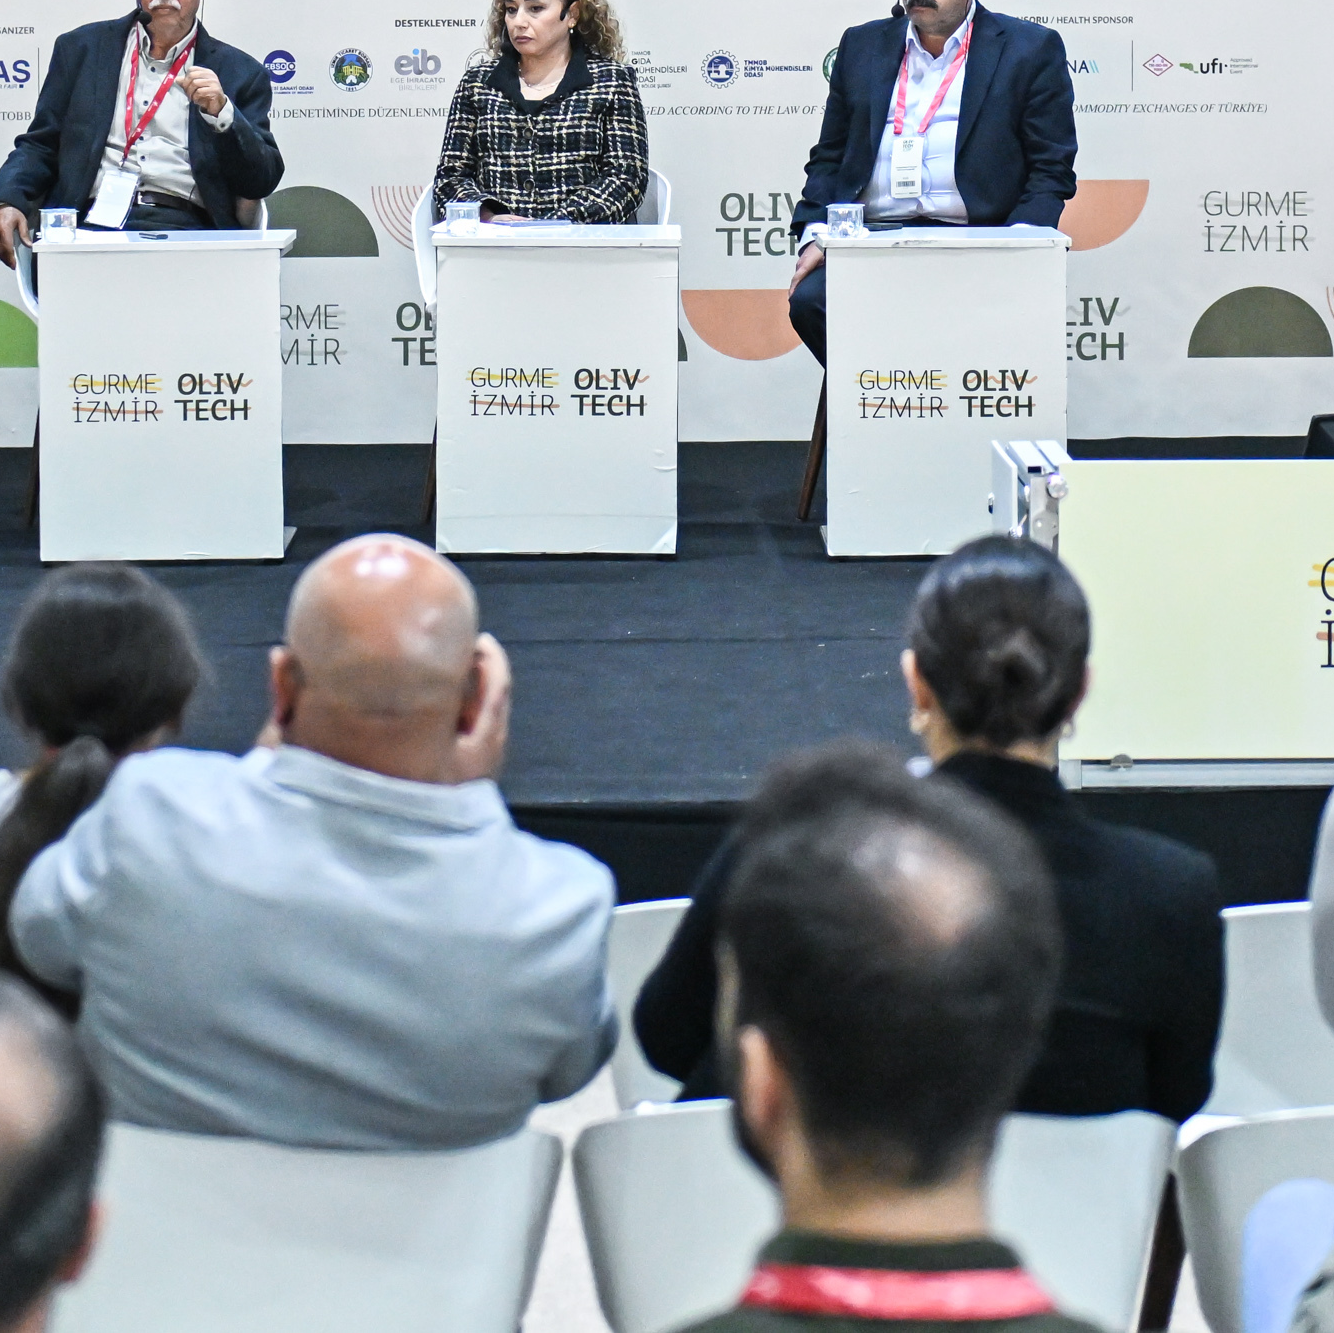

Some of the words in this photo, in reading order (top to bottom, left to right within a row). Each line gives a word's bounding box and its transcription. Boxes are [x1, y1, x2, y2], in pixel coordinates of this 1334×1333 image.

[394, 19, 476, 28] DESTEKLEYENLER
[1056, 16, 1091, 24] HEALTH
[1092, 16, 1134, 24] SPONSOR
[394, 48, 442, 76] eib
[283, 106, 365, 119] DENETİMİNDE
[667, 105, 733, 116] ACCORDING
[735, 105, 750, 115] TO
[752, 105, 774, 115] THE
[776, 105, 799, 115] LAW
[801, 105, 818, 115] OF
[1132, 103, 1198, 114] EXCHANGES
[1200, 103, 1216, 113] OF
[1218, 102, 1268, 114] TÜRKİYE)
[1204, 190, 1308, 217] GURME
[1204, 220, 1309, 252] İZMİR
[73, 373, 157, 395] GURME
[177, 372, 245, 396] OLIV
[471, 367, 554, 389] GURME
[574, 368, 641, 391] OLIV
[860, 369, 943, 391] GURME
[962, 369, 1029, 392] OLIV
[73, 396, 159, 423] İZMİR
[174, 399, 249, 421] TECH
[471, 389, 555, 416] İZMİR
[570, 394, 645, 416] TECH
[860, 392, 944, 419] İZMİR
[959, 395, 1033, 417] TECH
